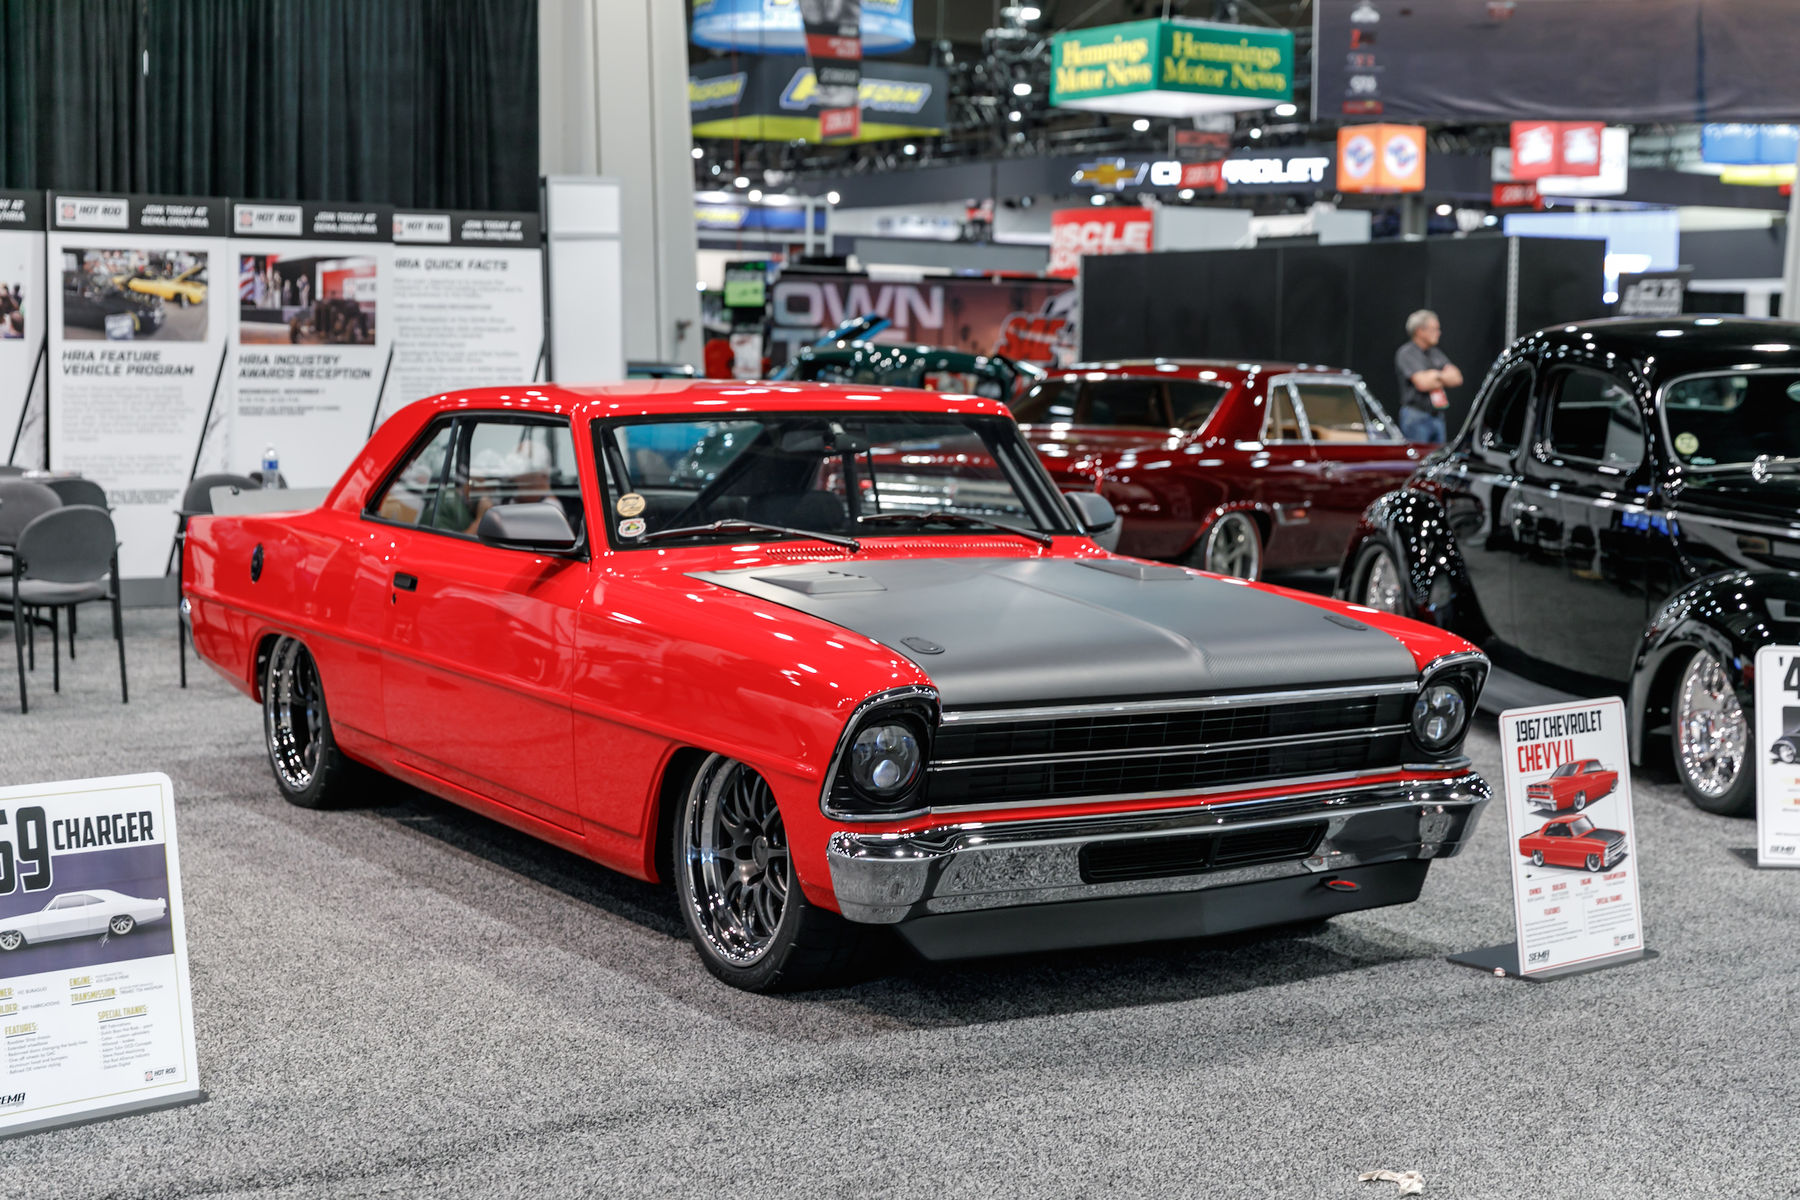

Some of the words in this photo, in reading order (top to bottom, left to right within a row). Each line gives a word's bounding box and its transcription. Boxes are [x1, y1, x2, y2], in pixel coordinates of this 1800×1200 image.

[1062, 35, 1149, 67] Hemmings
[1171, 31, 1281, 69] Hemmings
[1056, 66, 1105, 93] Motor
[1106, 62, 1152, 88] News
[1163, 57, 1227, 87] Motor
[1230, 62, 1287, 92] News
[467, 259, 509, 271] FACTS
[62, 364, 121, 376] VEHICLE
[127, 365, 194, 376] PROGRAM
[100, 350, 161, 361] FEATURE
[274, 355, 340, 366] INDUSTRY
[239, 368, 295, 378] AWARDS
[299, 368, 371, 379] RECEPTION
[1516, 718, 1540, 742] 1967
[1543, 710, 1602, 738] CHEVROLET
[1517, 740, 1561, 773] CHEVY
[52, 810, 154, 851] CHARGER
[0, 1092, 26, 1105] EMA
